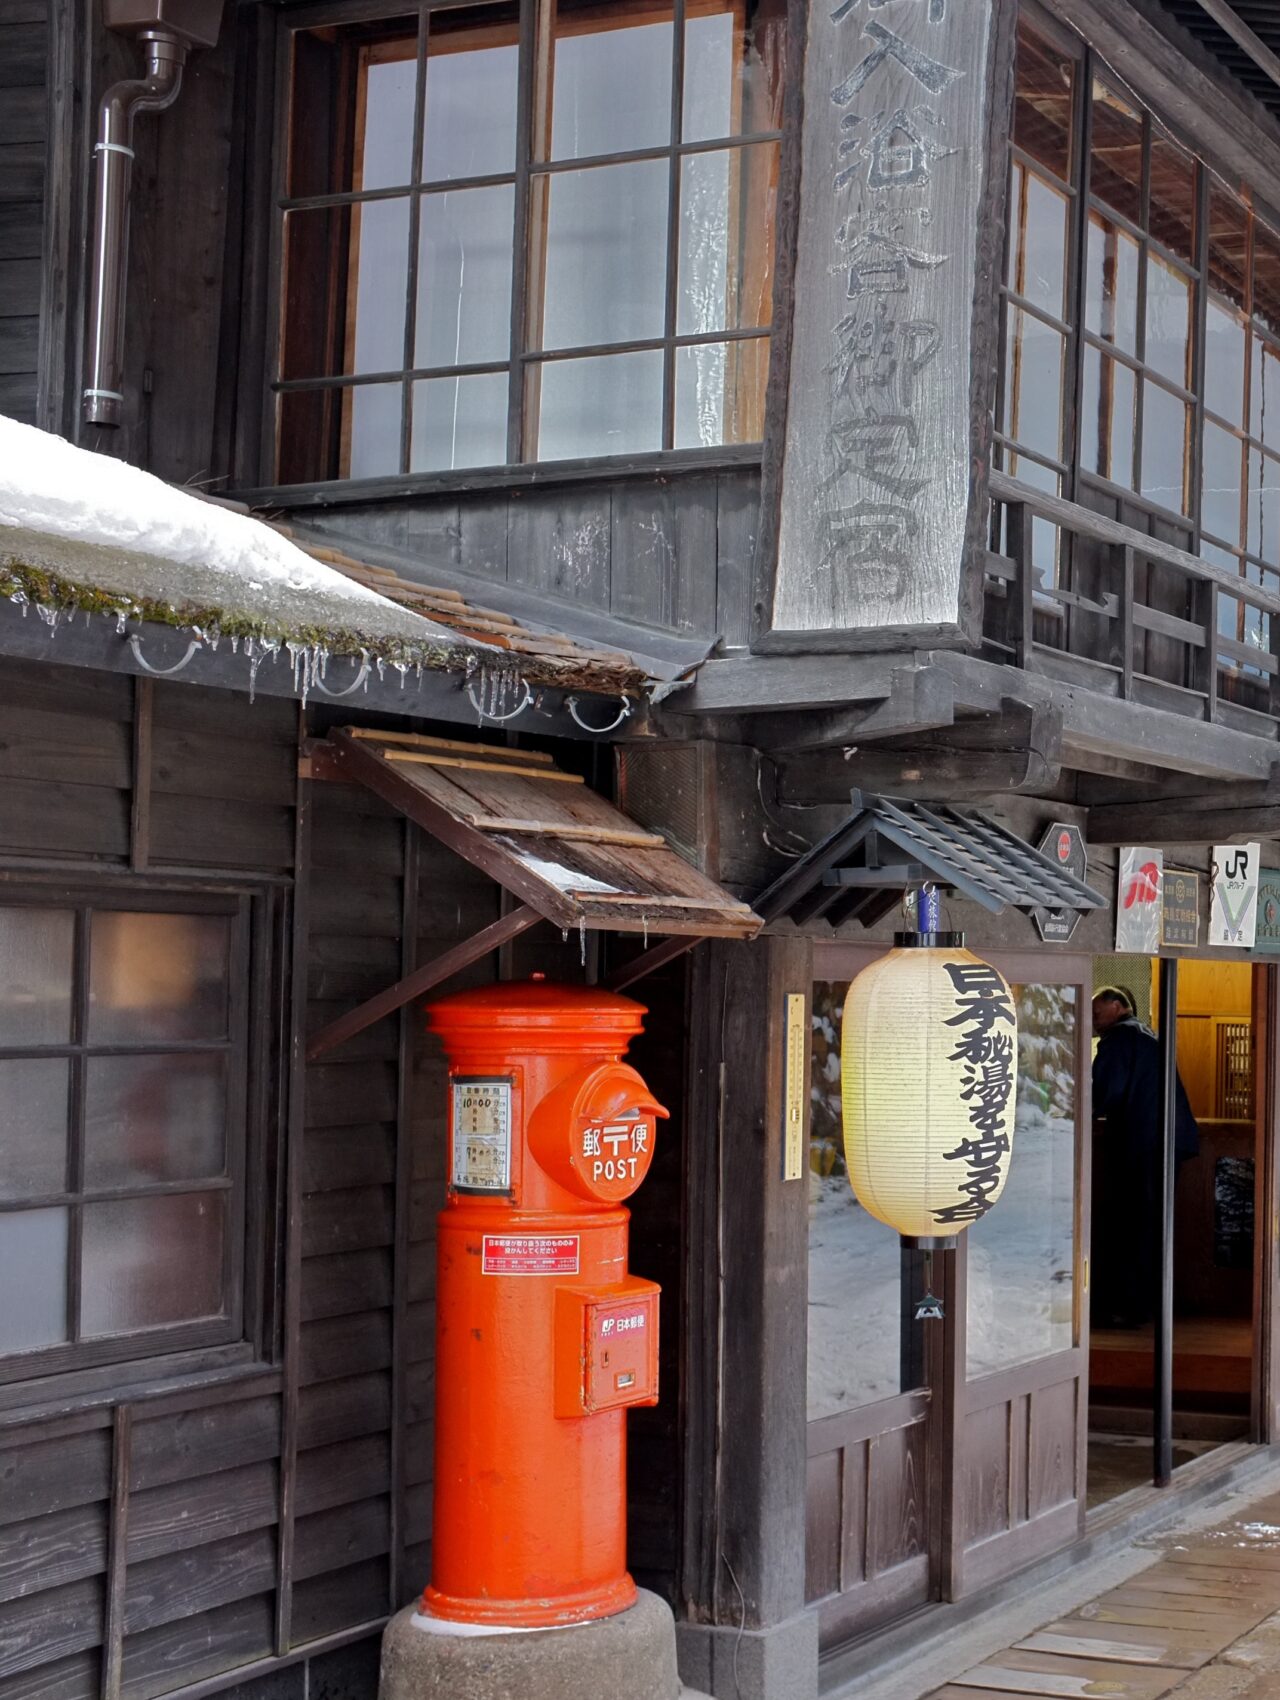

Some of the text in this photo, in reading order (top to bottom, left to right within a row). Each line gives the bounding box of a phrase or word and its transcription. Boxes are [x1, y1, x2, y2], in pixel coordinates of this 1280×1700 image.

[805, 0, 966, 602] 入浴客御定宿
[1225, 850, 1249, 880] JR
[928, 963, 1017, 1224] 日本秘湯を守る会
[593, 1157, 638, 1182] POST
[616, 1314, 645, 1333] 日本郵便
